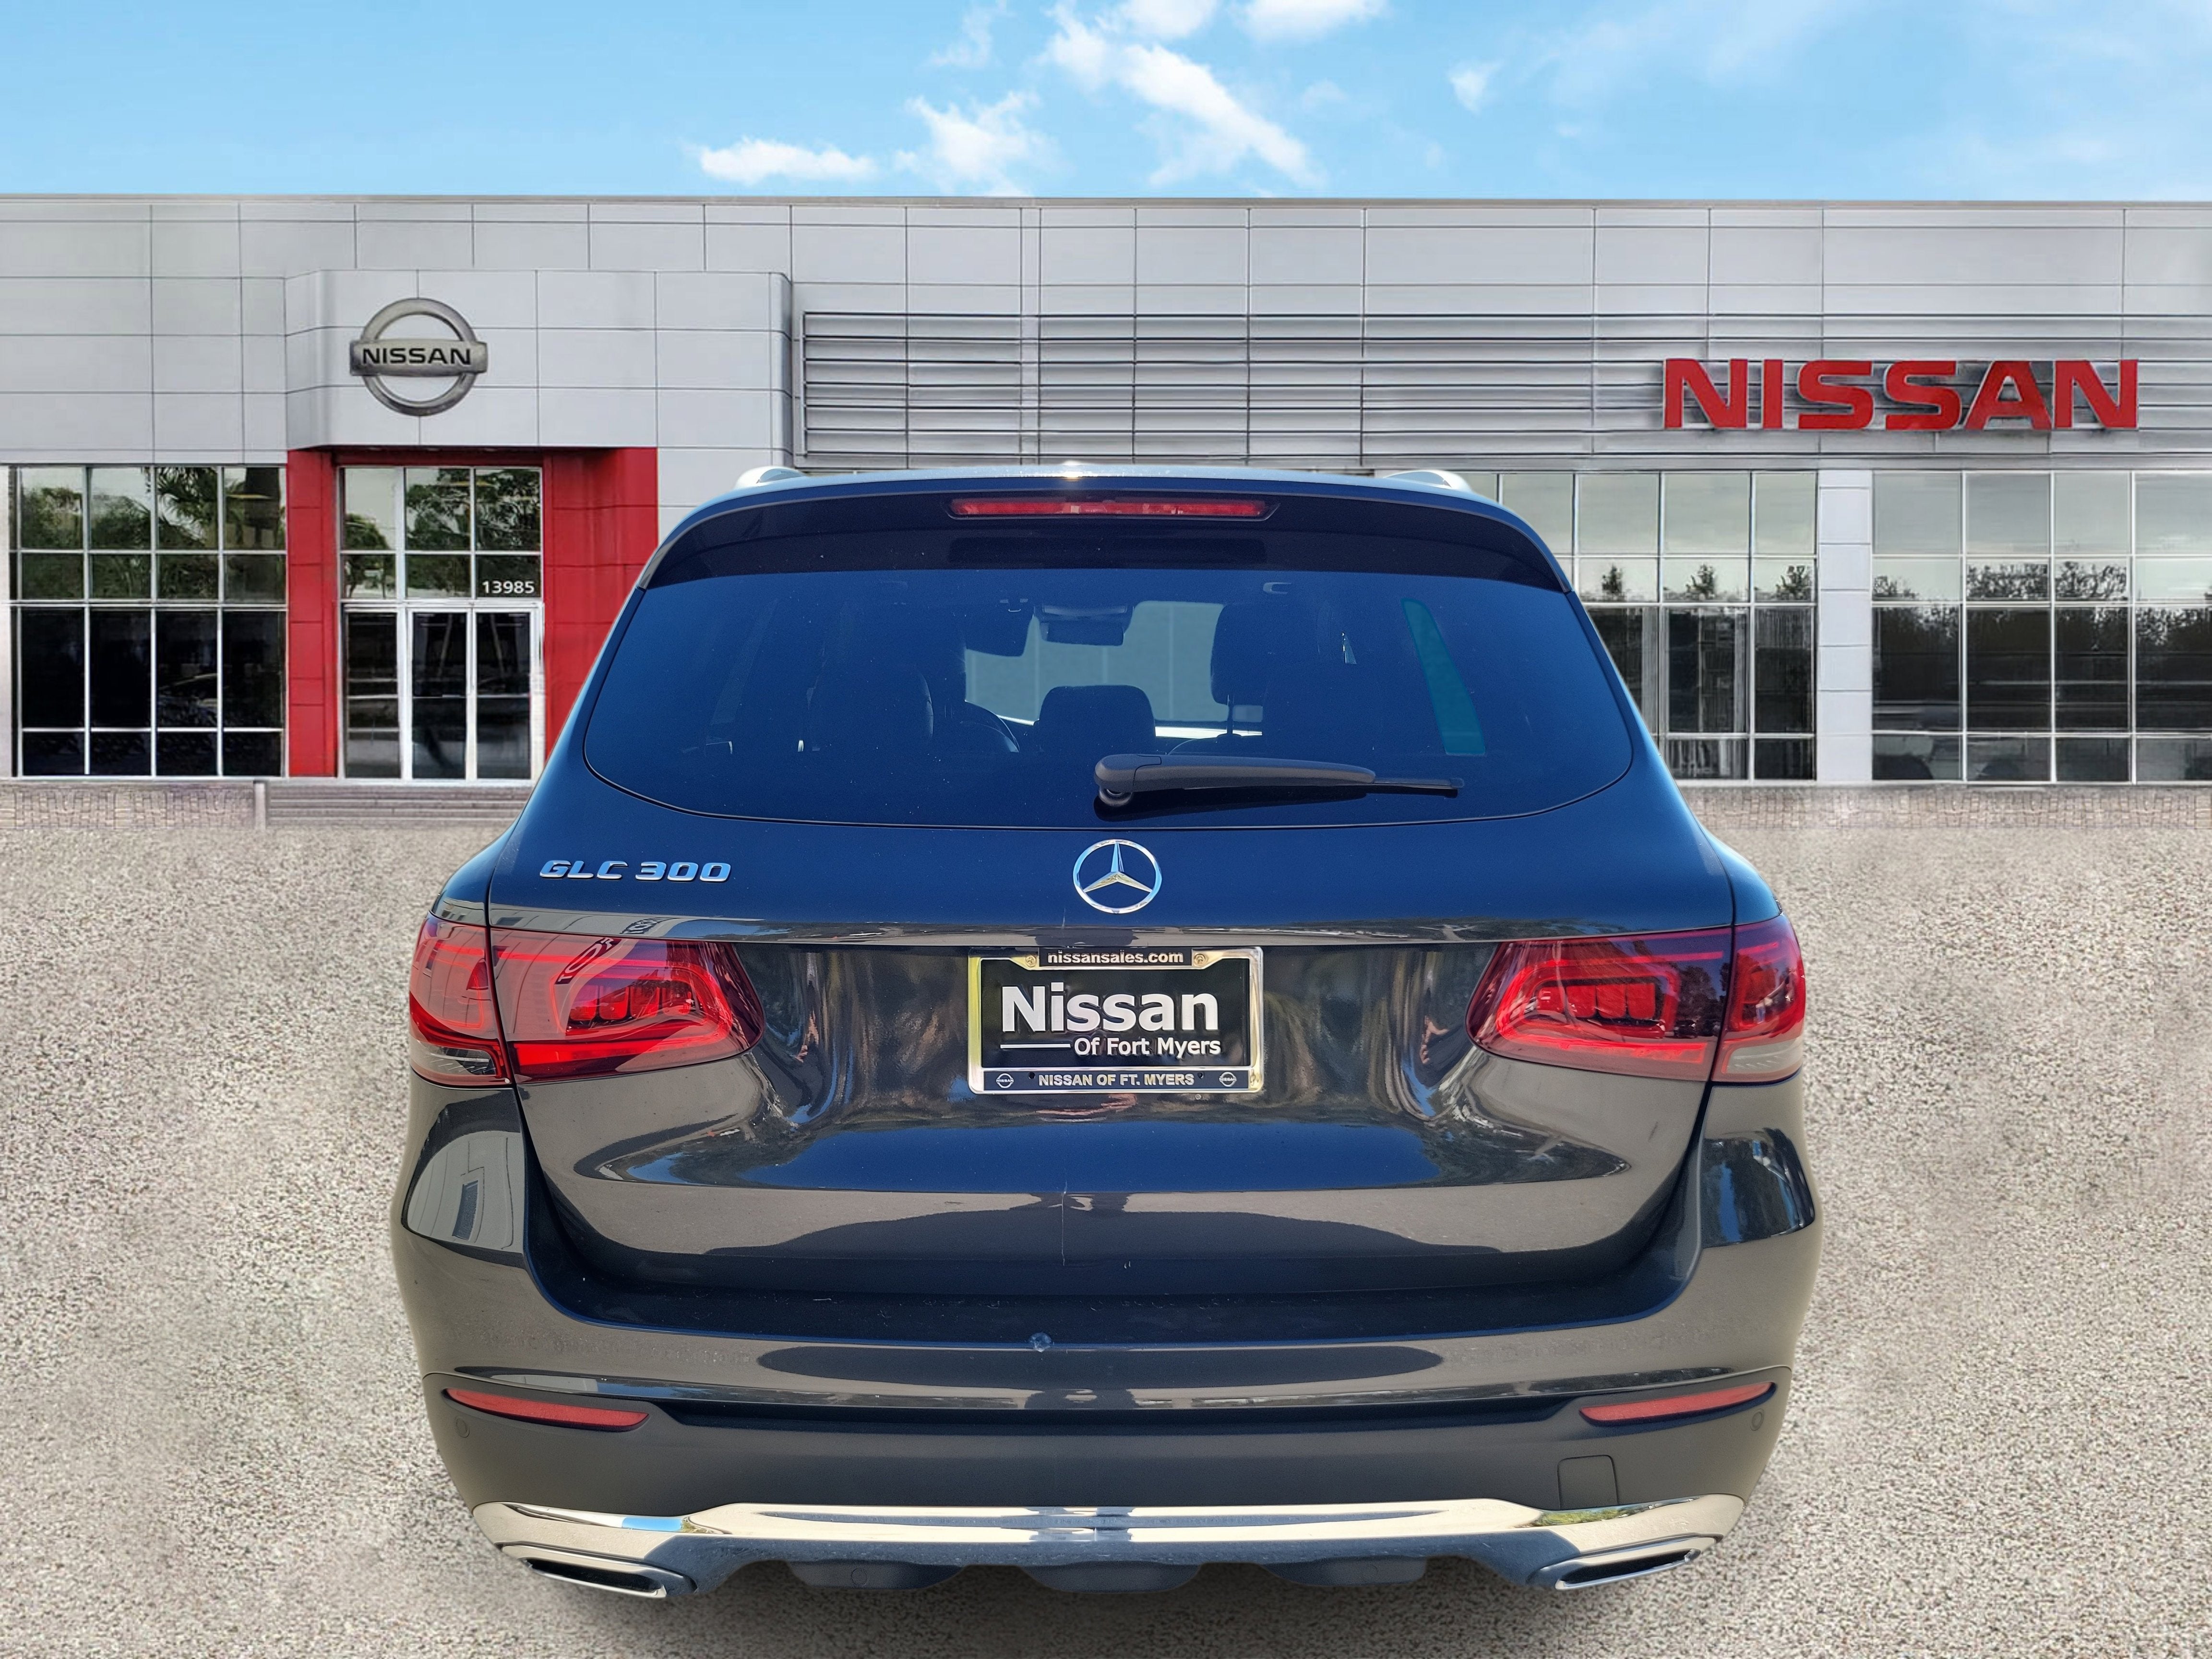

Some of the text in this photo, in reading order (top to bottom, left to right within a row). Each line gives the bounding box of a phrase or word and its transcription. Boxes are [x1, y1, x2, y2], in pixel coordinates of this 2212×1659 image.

[363, 348, 471, 365] NISSAN
[1663, 358, 2138, 430] NISSAN
[482, 580, 535, 594] 13985
[539, 860, 731, 882] GLC 300
[1048, 950, 1184, 963] nissansales.com
[1002, 982, 1218, 1032] Nissan
[1074, 1037, 1221, 1059] Of Fort Myers
[1039, 1073, 1195, 1086] NISSAN OF FT. MYERS
